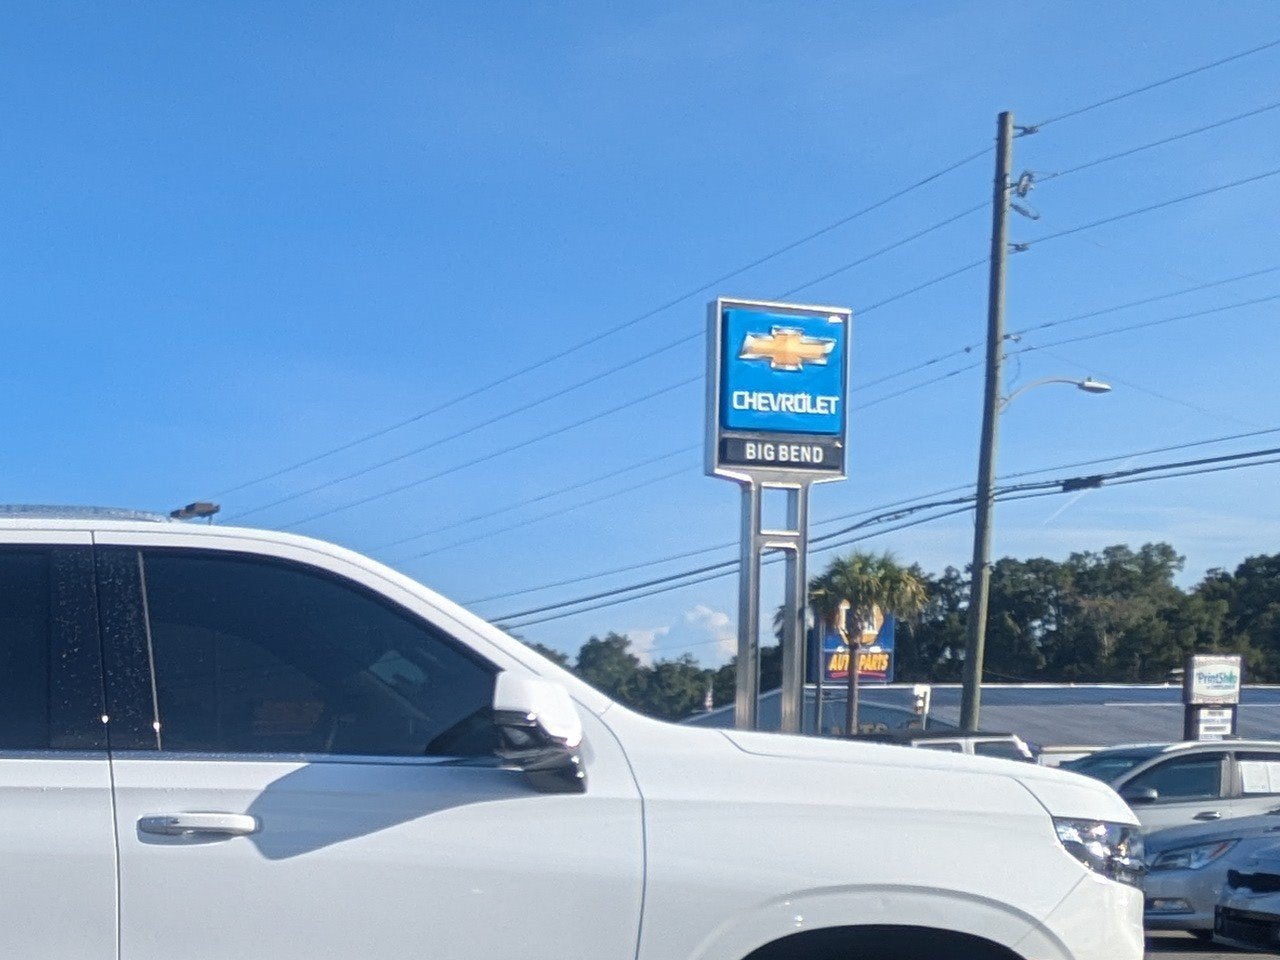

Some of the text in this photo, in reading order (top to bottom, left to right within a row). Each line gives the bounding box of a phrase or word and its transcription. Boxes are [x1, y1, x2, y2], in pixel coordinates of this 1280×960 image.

[733, 391, 840, 414] CHEVROLET
[745, 442, 824, 463] BIG BEND
[828, 653, 890, 672] AUT PARTS
